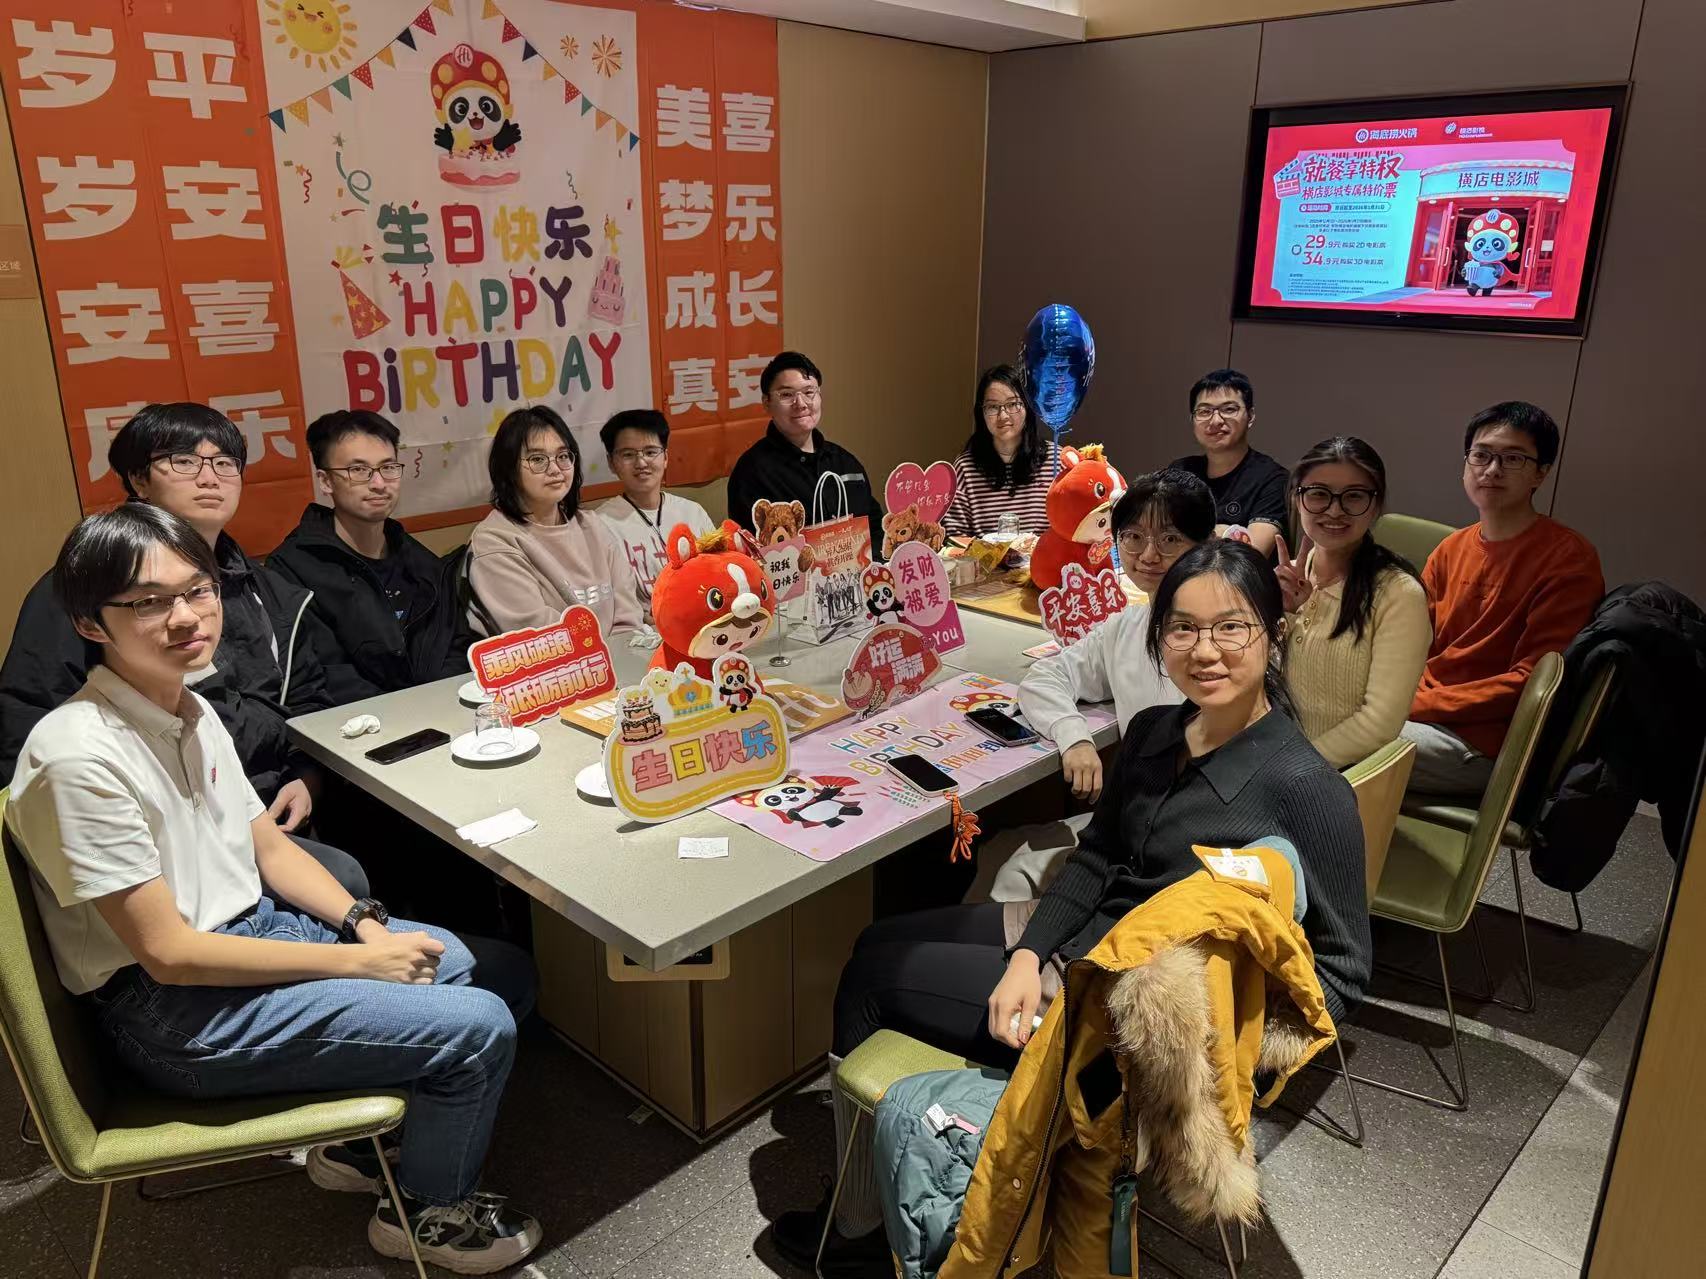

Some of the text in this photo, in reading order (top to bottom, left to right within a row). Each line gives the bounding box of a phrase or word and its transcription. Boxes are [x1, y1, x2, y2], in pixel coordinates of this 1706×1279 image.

[1303, 157, 1402, 183] 就餐享特权
[1459, 171, 1540, 188] 横店电影城
[1301, 182, 1398, 200] 横店影城专属特价票
[377, 203, 593, 265] 生日快乐
[656, 84, 719, 415] 美梦成真
[402, 275, 573, 337] HAPPY
[770, 556, 791, 573] 祝我
[772, 571, 800, 590] 日快乐
[898, 552, 936, 585] 发财
[905, 582, 944, 614] 被爱
[1046, 577, 1124, 631] 平安喜乐
[482, 629, 573, 679] 乘风破浪
[868, 636, 904, 668] 好运
[501, 653, 607, 716] 砥砺前行
[831, 716, 915, 754] HAPPY
[631, 720, 778, 794] 生日快乐
